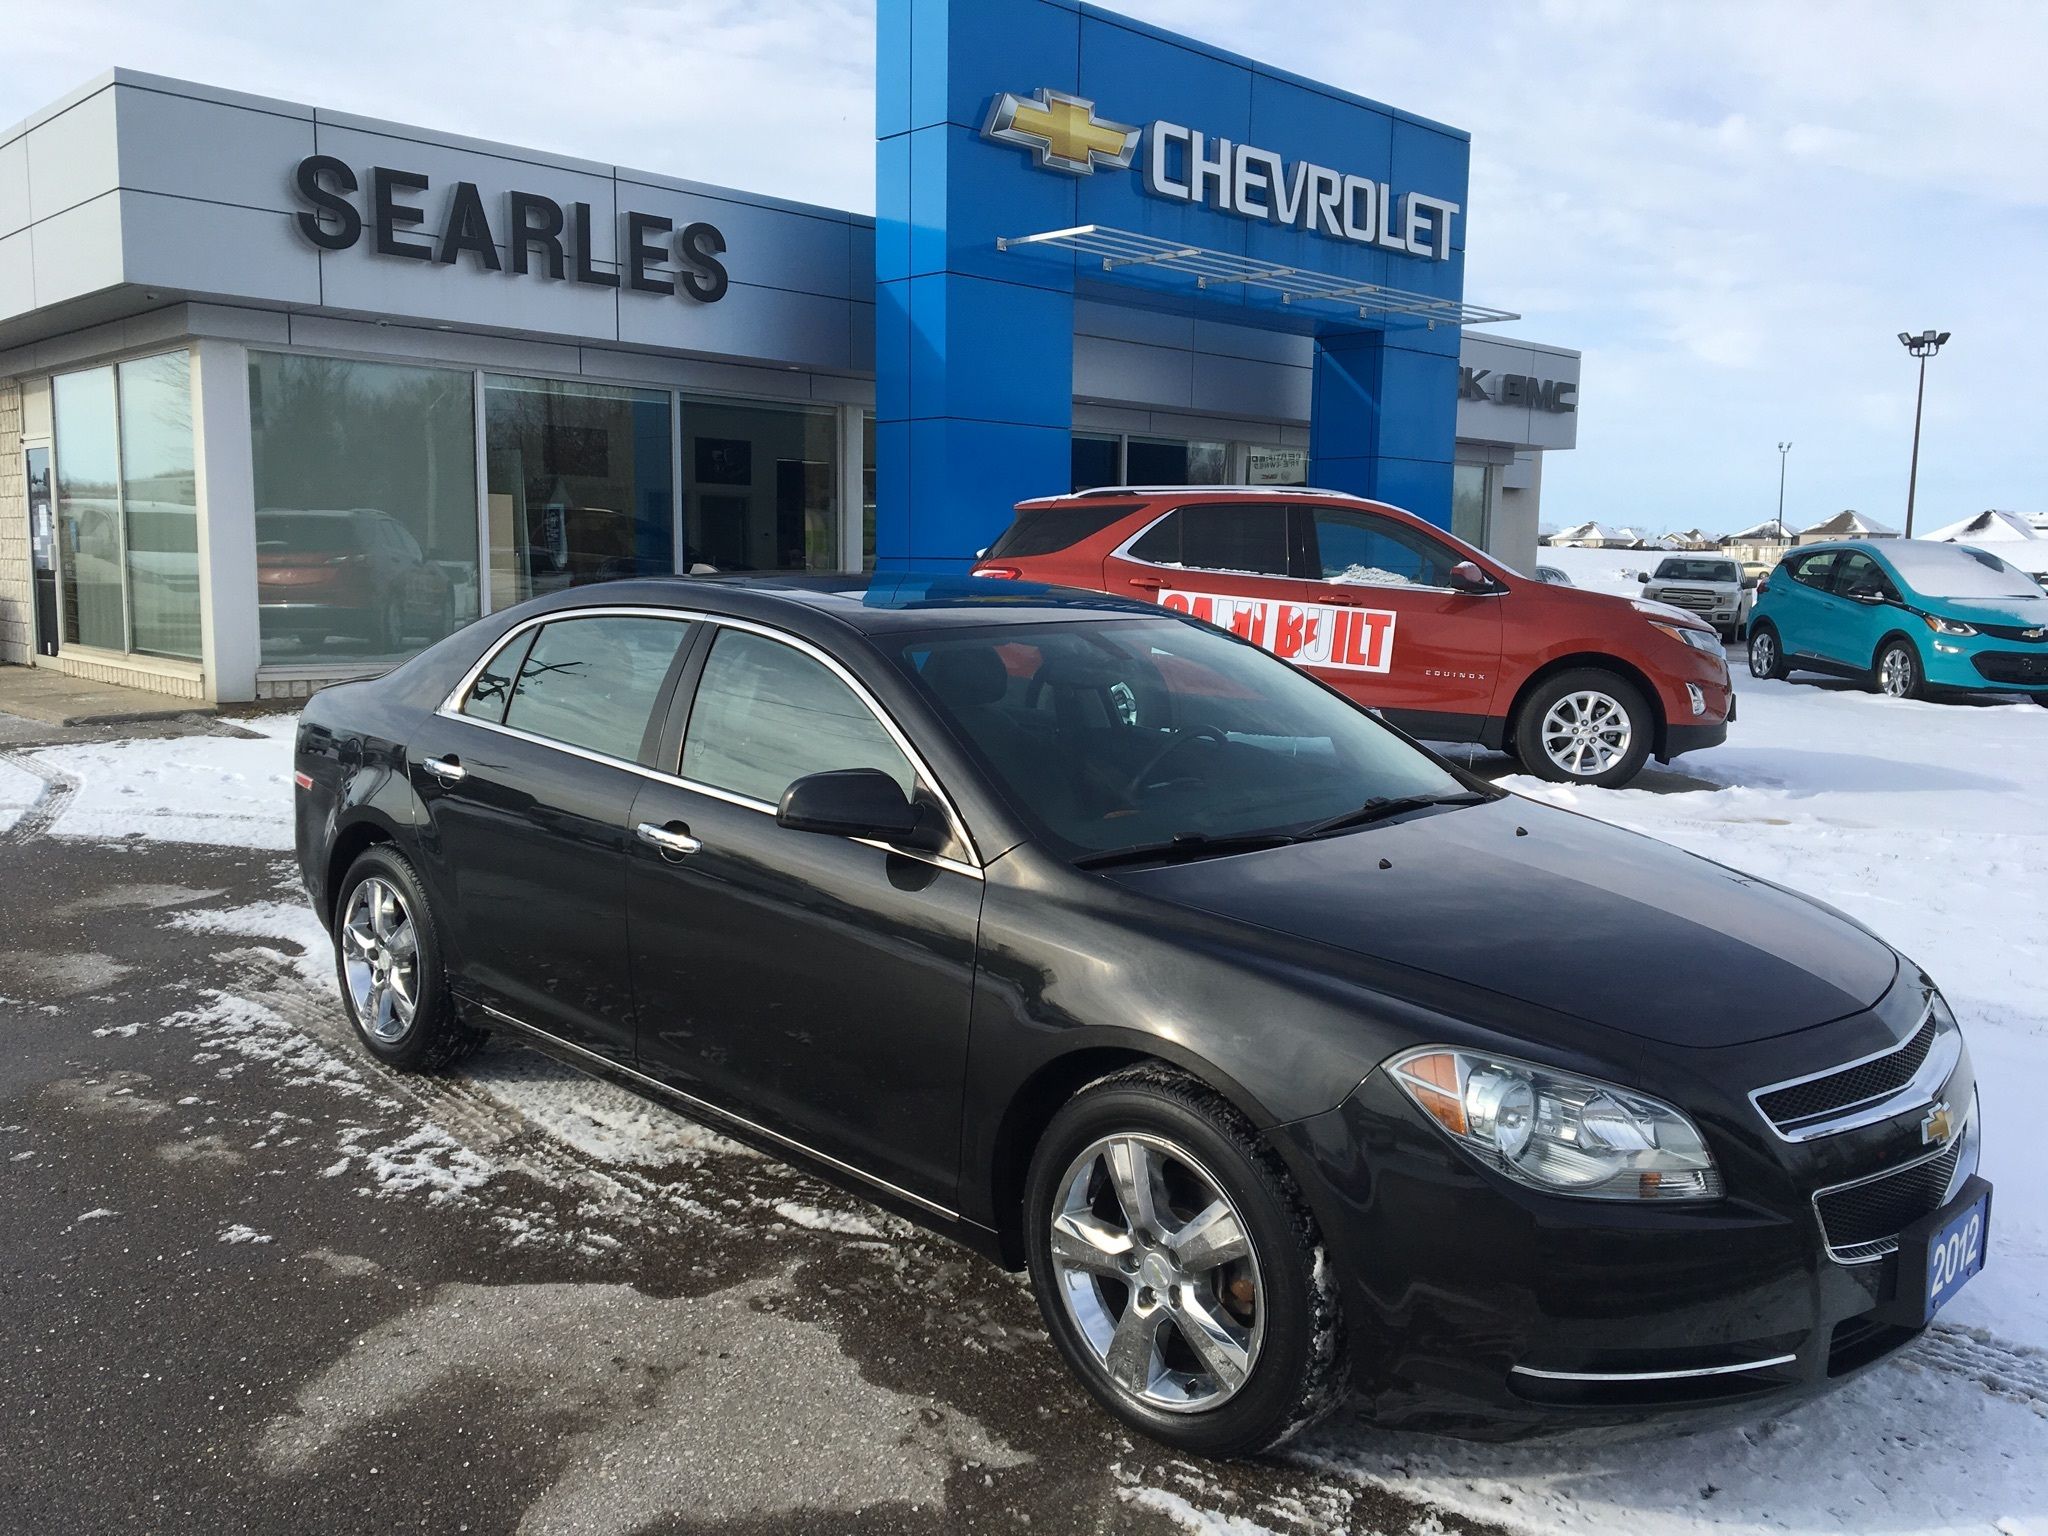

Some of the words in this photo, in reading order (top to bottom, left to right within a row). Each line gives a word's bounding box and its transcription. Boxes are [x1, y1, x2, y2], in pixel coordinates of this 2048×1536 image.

[1150, 119, 1460, 261] CHEVROLET
[294, 154, 729, 303] SEARLES
[1458, 365, 1491, 401] K
[1501, 373, 1577, 413] GMC
[1273, 604, 1391, 668] BUILT
[1425, 669, 1486, 680] EQUINOX
[1930, 1213, 1980, 1299] 2012
